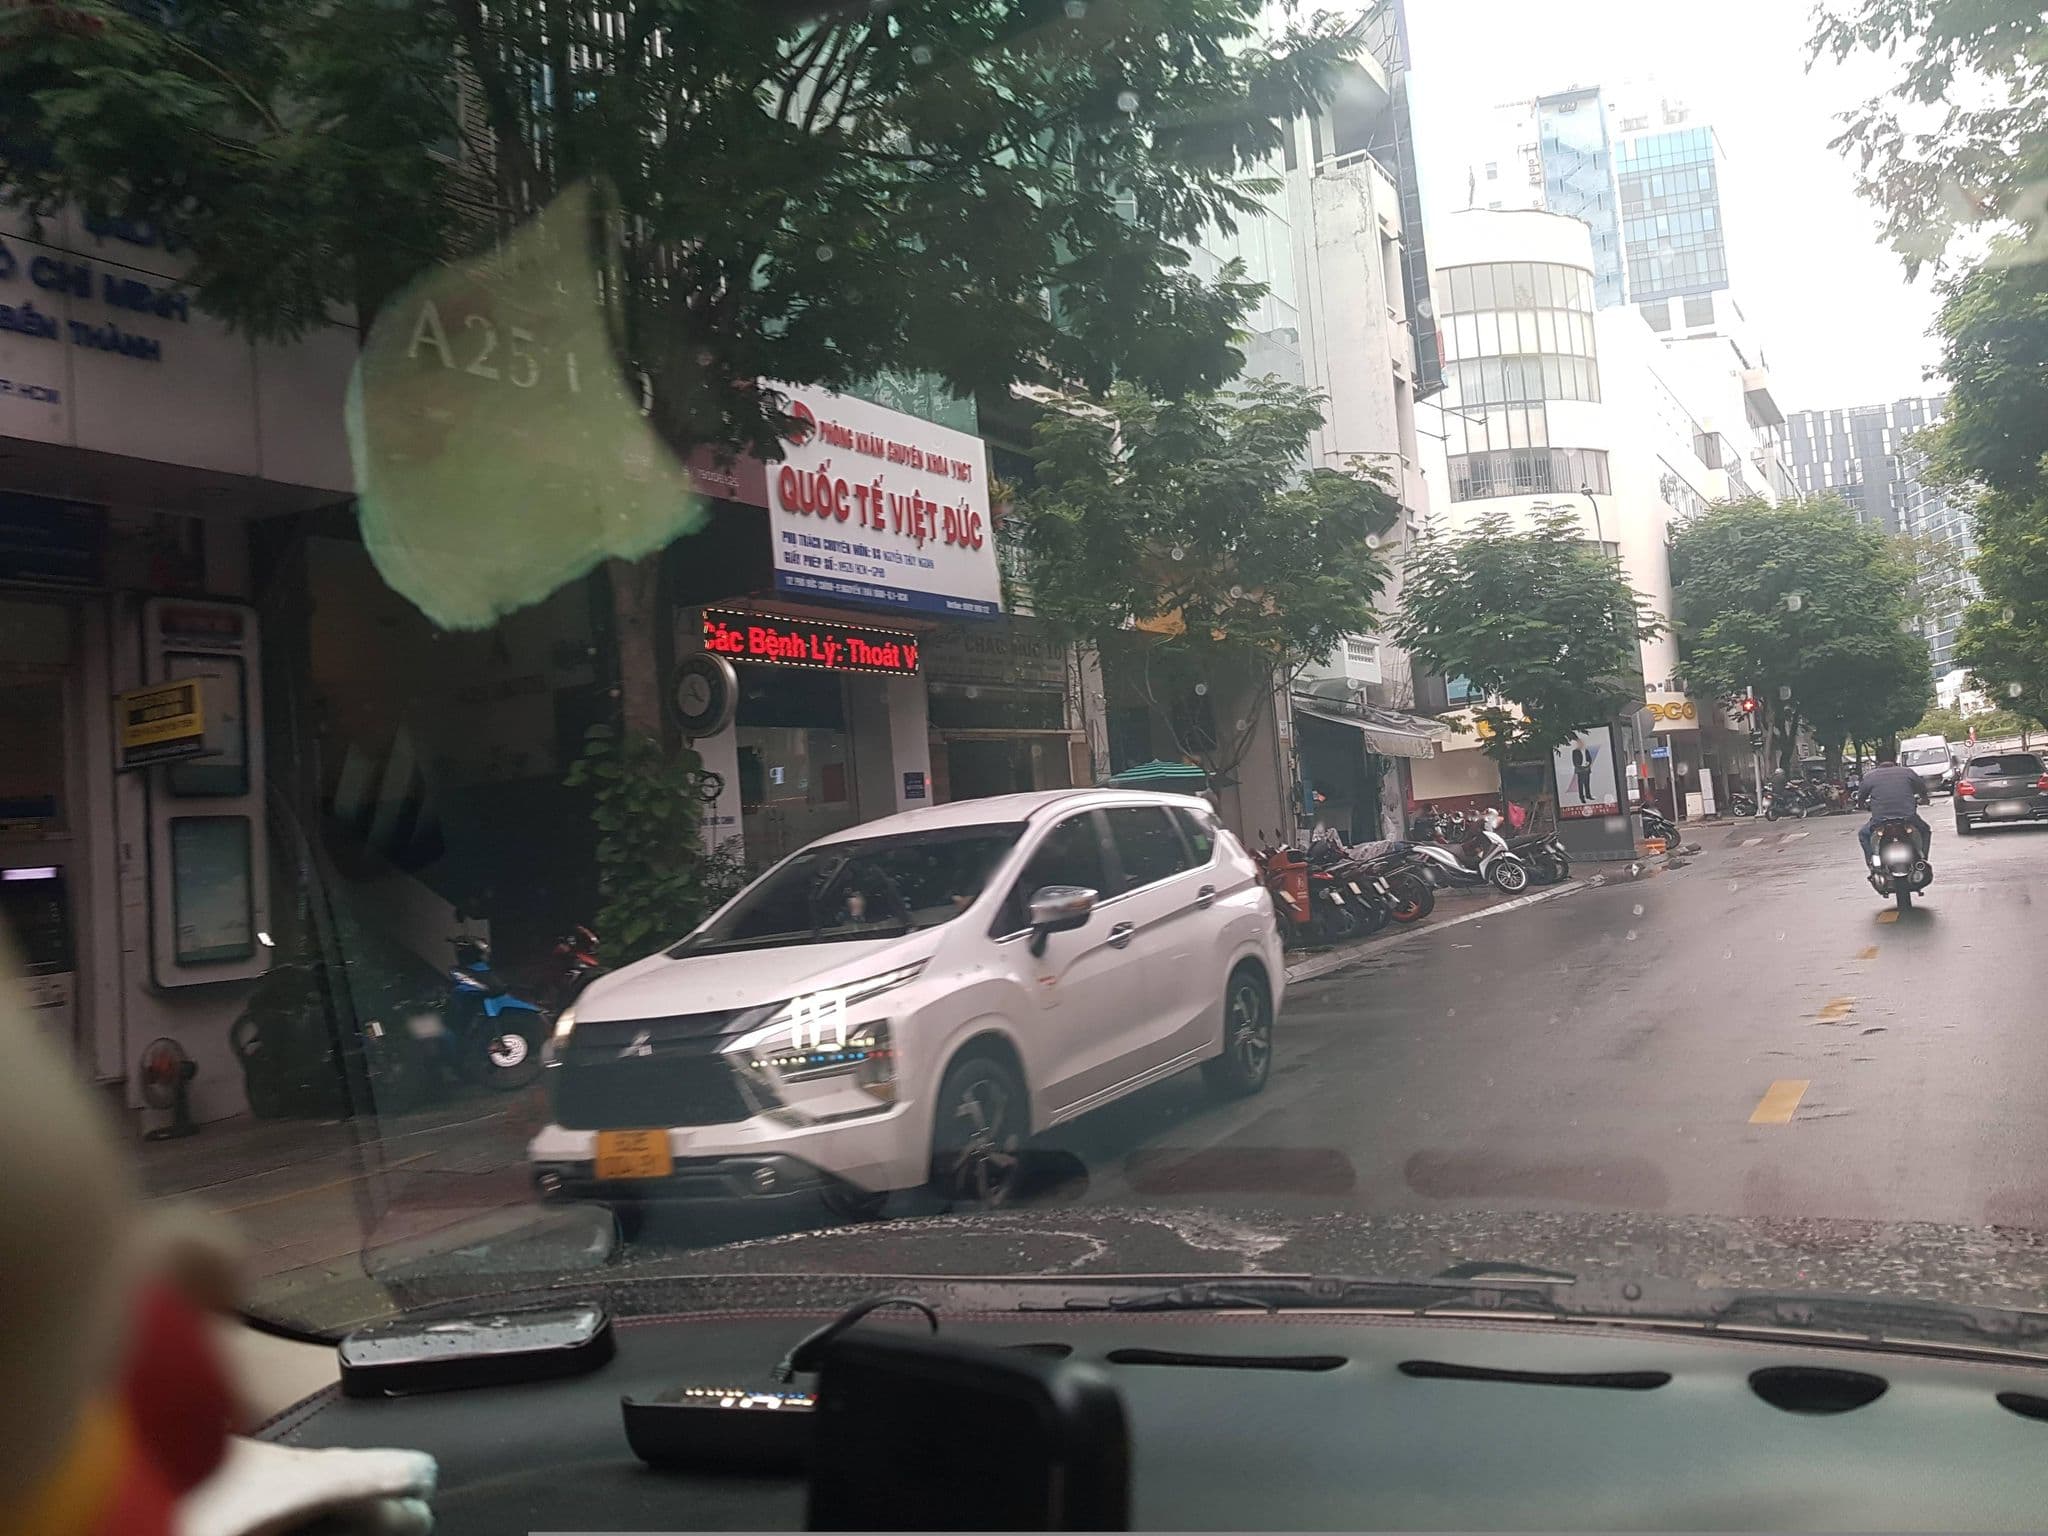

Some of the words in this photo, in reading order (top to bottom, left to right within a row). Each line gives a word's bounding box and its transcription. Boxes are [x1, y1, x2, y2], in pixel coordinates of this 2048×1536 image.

[778, 459, 851, 522] QUỐC
[854, 474, 886, 531] TẾ
[888, 489, 938, 549] VIỆT
[942, 497, 983, 550] ĐỨC
[748, 627, 806, 661] Bệnh
[811, 634, 844, 667] Lý:
